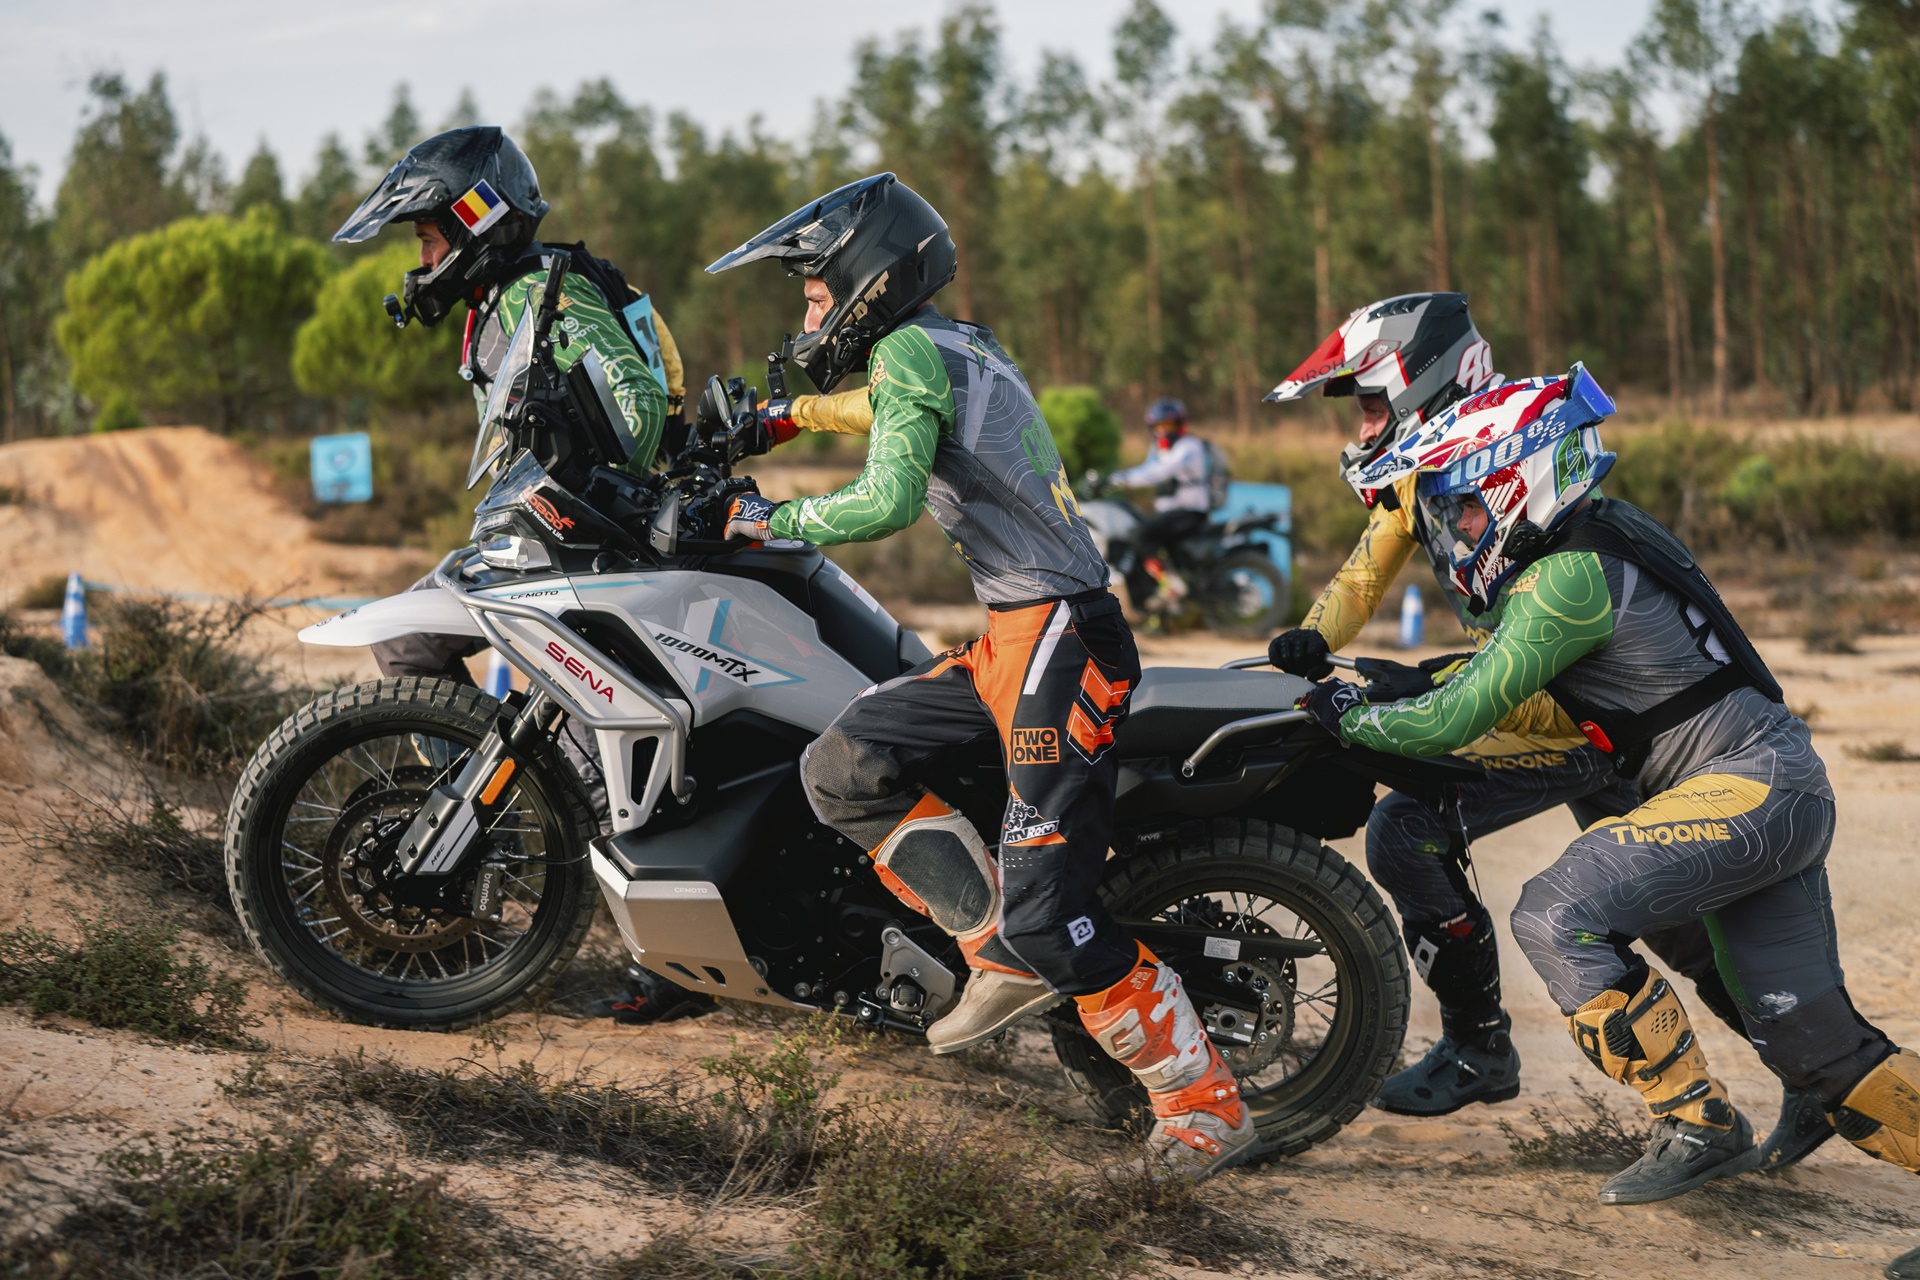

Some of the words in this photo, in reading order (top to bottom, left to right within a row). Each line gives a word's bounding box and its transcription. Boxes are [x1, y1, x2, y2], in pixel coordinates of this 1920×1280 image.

[1449, 408, 1567, 487] 100%
[510, 590, 559, 600] CFMOTO
[544, 641, 615, 704] SENA
[1013, 729, 1056, 746] TWO
[1013, 745, 1058, 763] ONE
[1610, 823, 1732, 846] TWOONE
[479, 872, 494, 911] brembo
